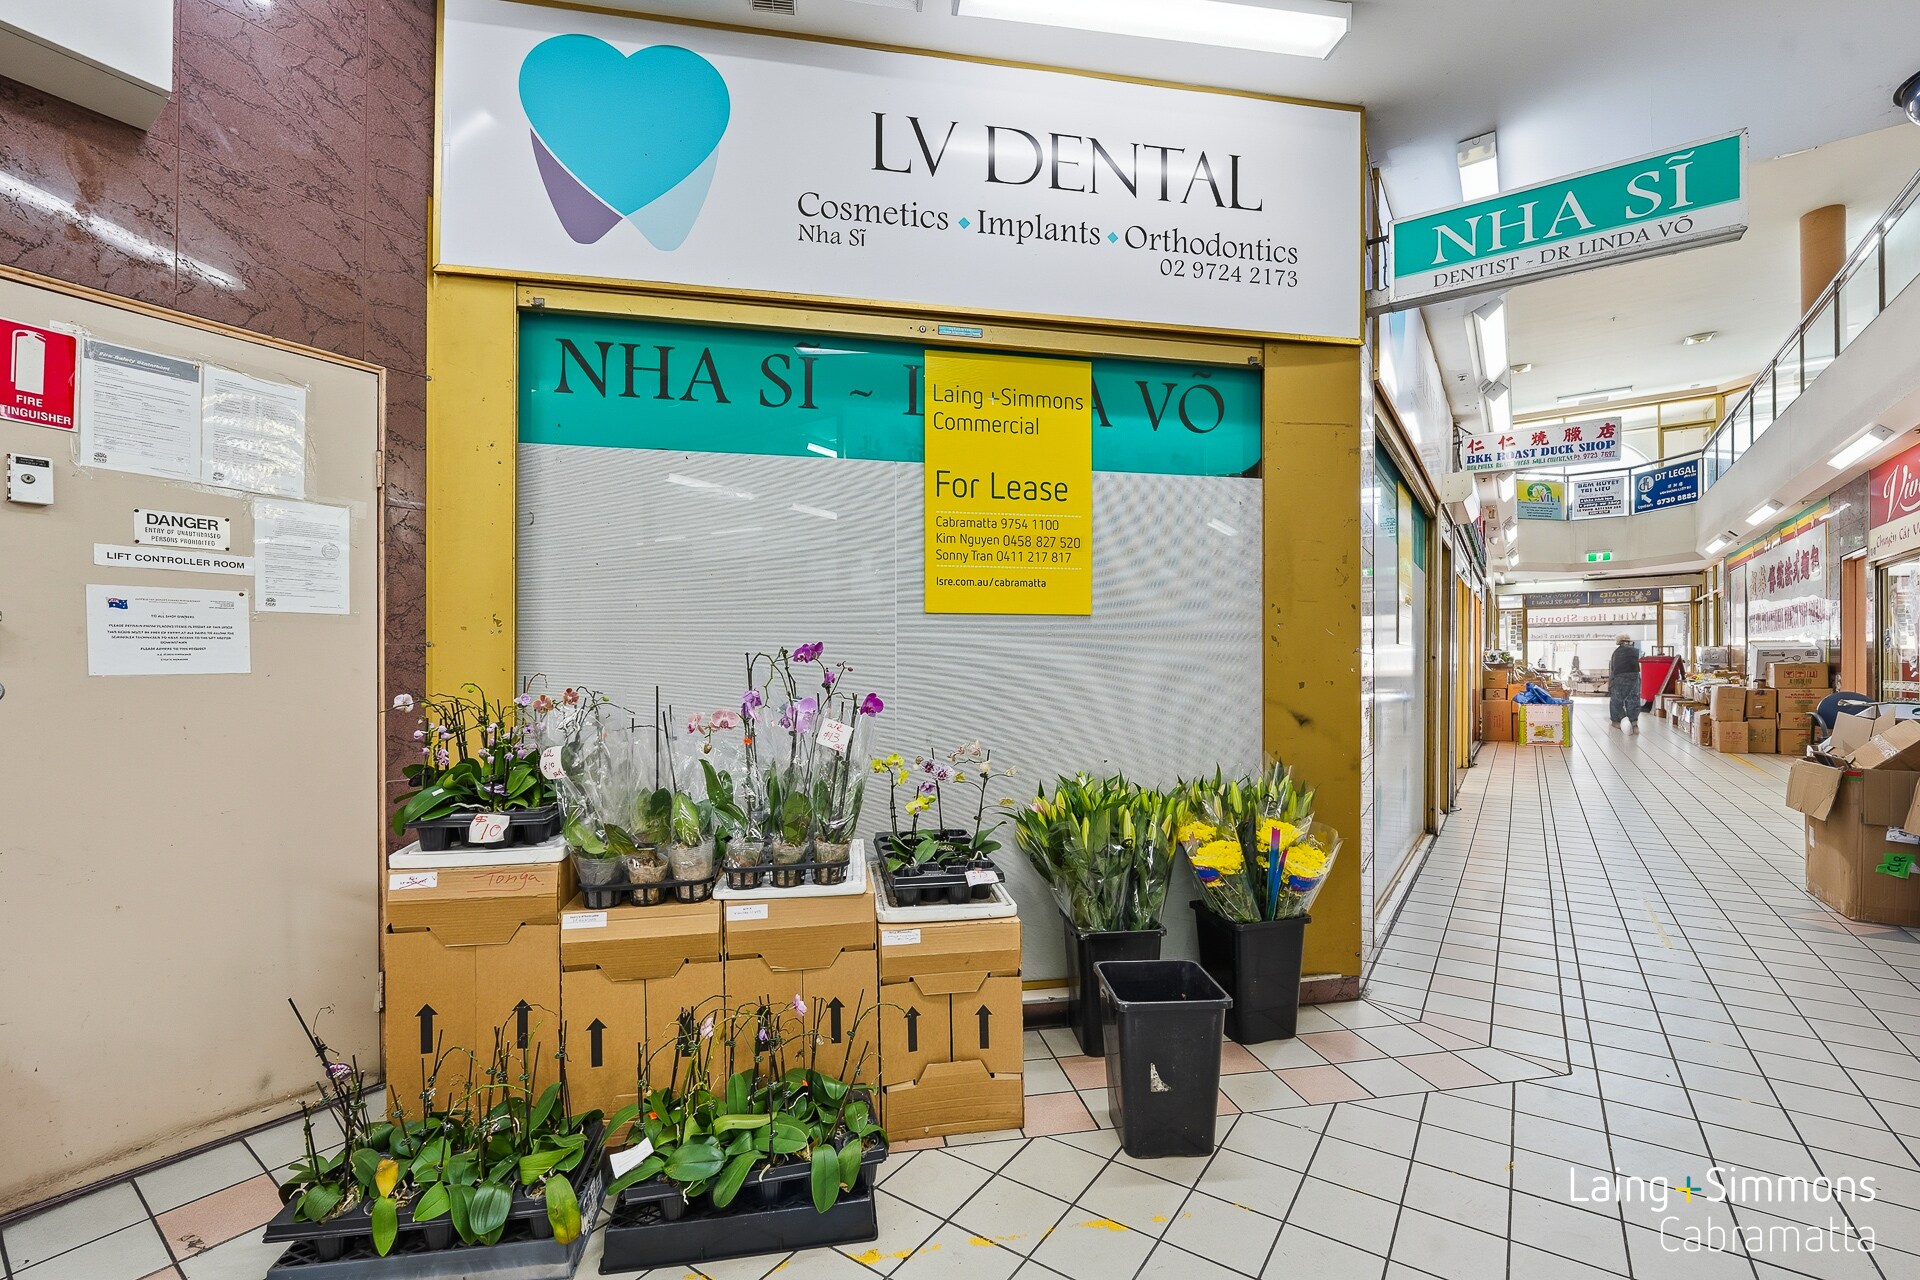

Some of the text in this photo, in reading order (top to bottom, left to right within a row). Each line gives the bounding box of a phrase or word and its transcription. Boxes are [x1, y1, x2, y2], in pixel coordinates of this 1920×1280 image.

[871, 112, 1263, 212] LV DENTAL
[1431, 150, 1696, 266] NHA SĨ
[797, 191, 1298, 264] Cosmetics Implants Orthodontics
[798, 224, 842, 244] Nha
[1433, 256, 1520, 288] DENTIST
[1539, 245, 1572, 265] DR
[1578, 228, 1651, 256] LINDA
[1657, 214, 1694, 238] VÕ
[1160, 257, 1298, 288] 02 9724 2173
[553, 338, 730, 409] NHA
[1136, 373, 1227, 434] VÕ
[933, 383, 983, 409] Laing
[16, 394, 43, 408] FIRE
[933, 412, 1040, 436] Commercial
[1466, 454, 1492, 464] BKK
[1540, 444, 1575, 458] DUCK
[1578, 440, 1616, 452] SHOP
[1655, 472, 1666, 481] DT
[1668, 465, 1696, 478] LEGAL
[936, 470, 1069, 502] For Lease
[144, 526, 164, 534] ENTRY
[146, 513, 219, 531] DANGER
[936, 516, 1059, 531] Cabramatta 9754 1100
[151, 536, 178, 544] PERSONS
[936, 533, 1081, 549] Kim Nguyen 0458 827 520
[106, 552, 245, 569] LIFT CONTROLLER ROOM
[936, 549, 1072, 564] Sonny Tran 0411 217 817
[936, 576, 1047, 588] lsre.com.au/cabramatta
